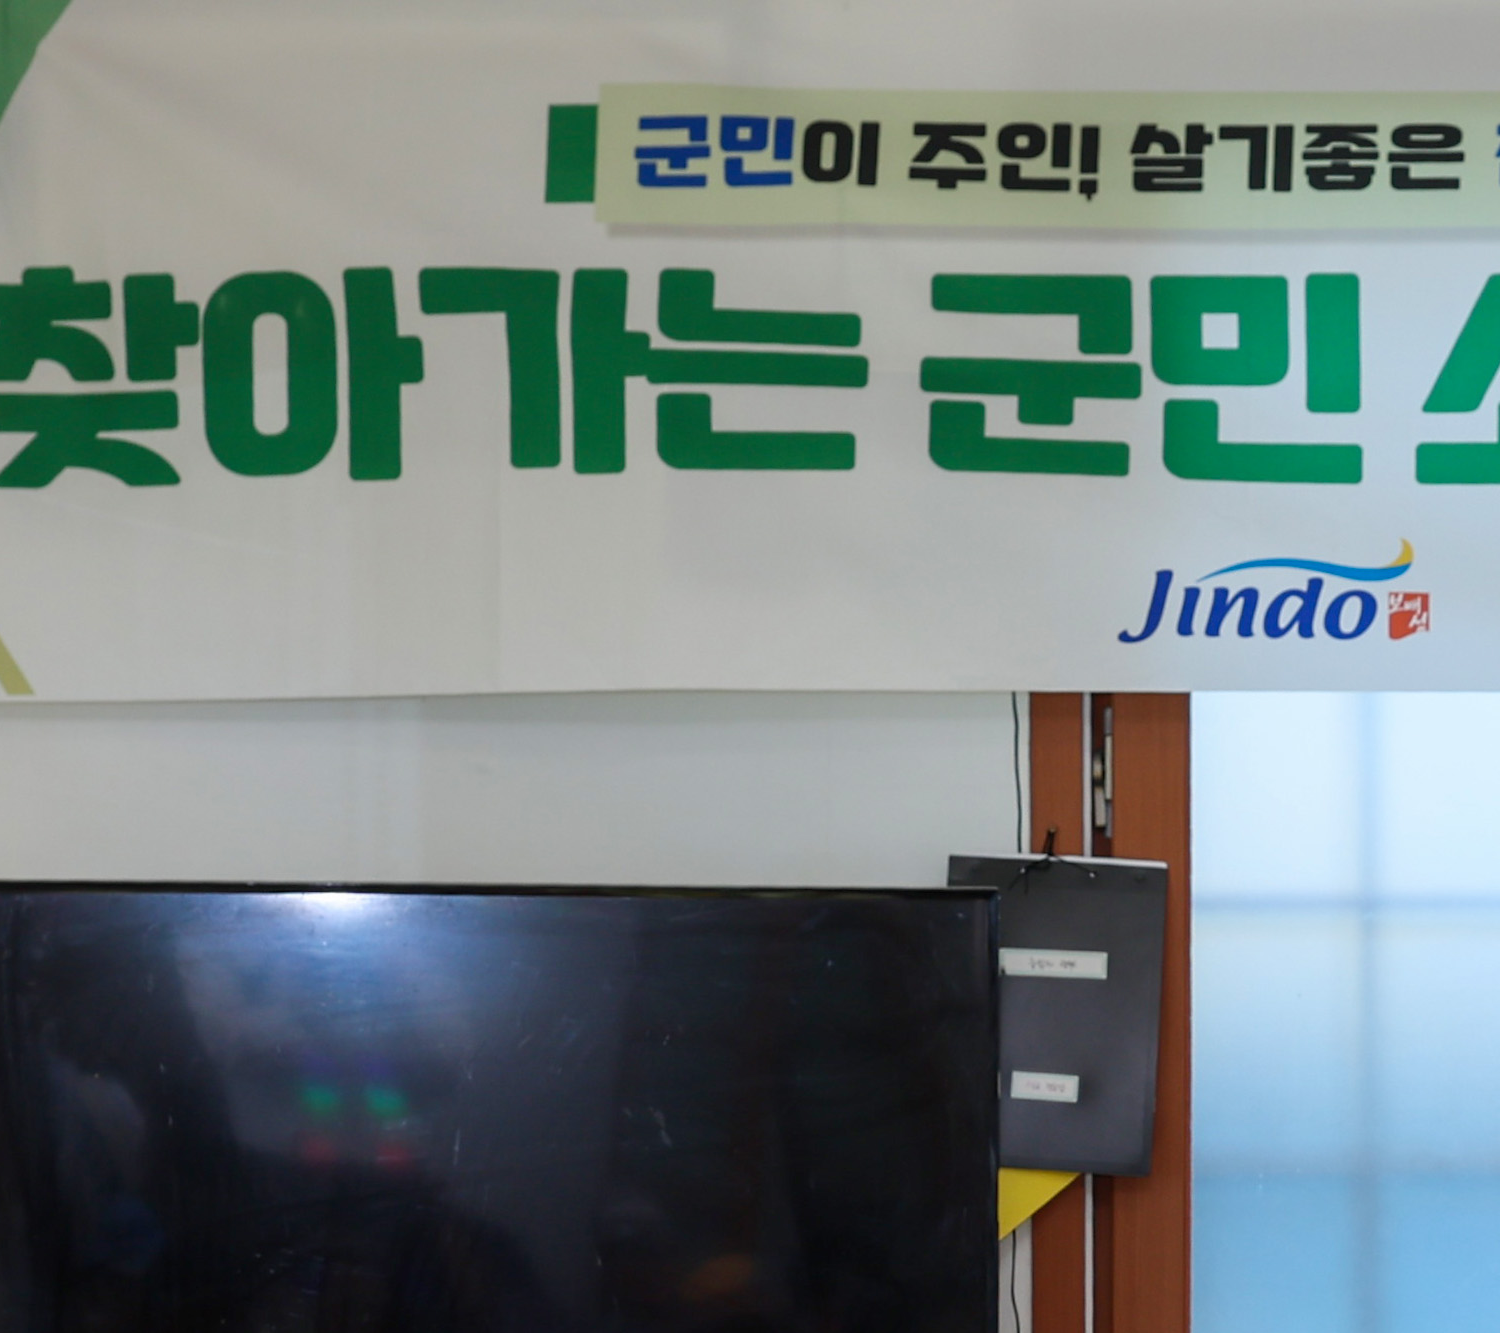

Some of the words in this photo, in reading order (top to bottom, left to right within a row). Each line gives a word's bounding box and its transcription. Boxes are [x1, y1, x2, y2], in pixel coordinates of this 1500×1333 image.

[635, 115, 880, 188] 군민이
[908, 122, 1101, 201] 주인!
[1129, 122, 1465, 192] 살기좋은
[919, 272, 1364, 485] 군민
[1118, 568, 1378, 643] Jindo
